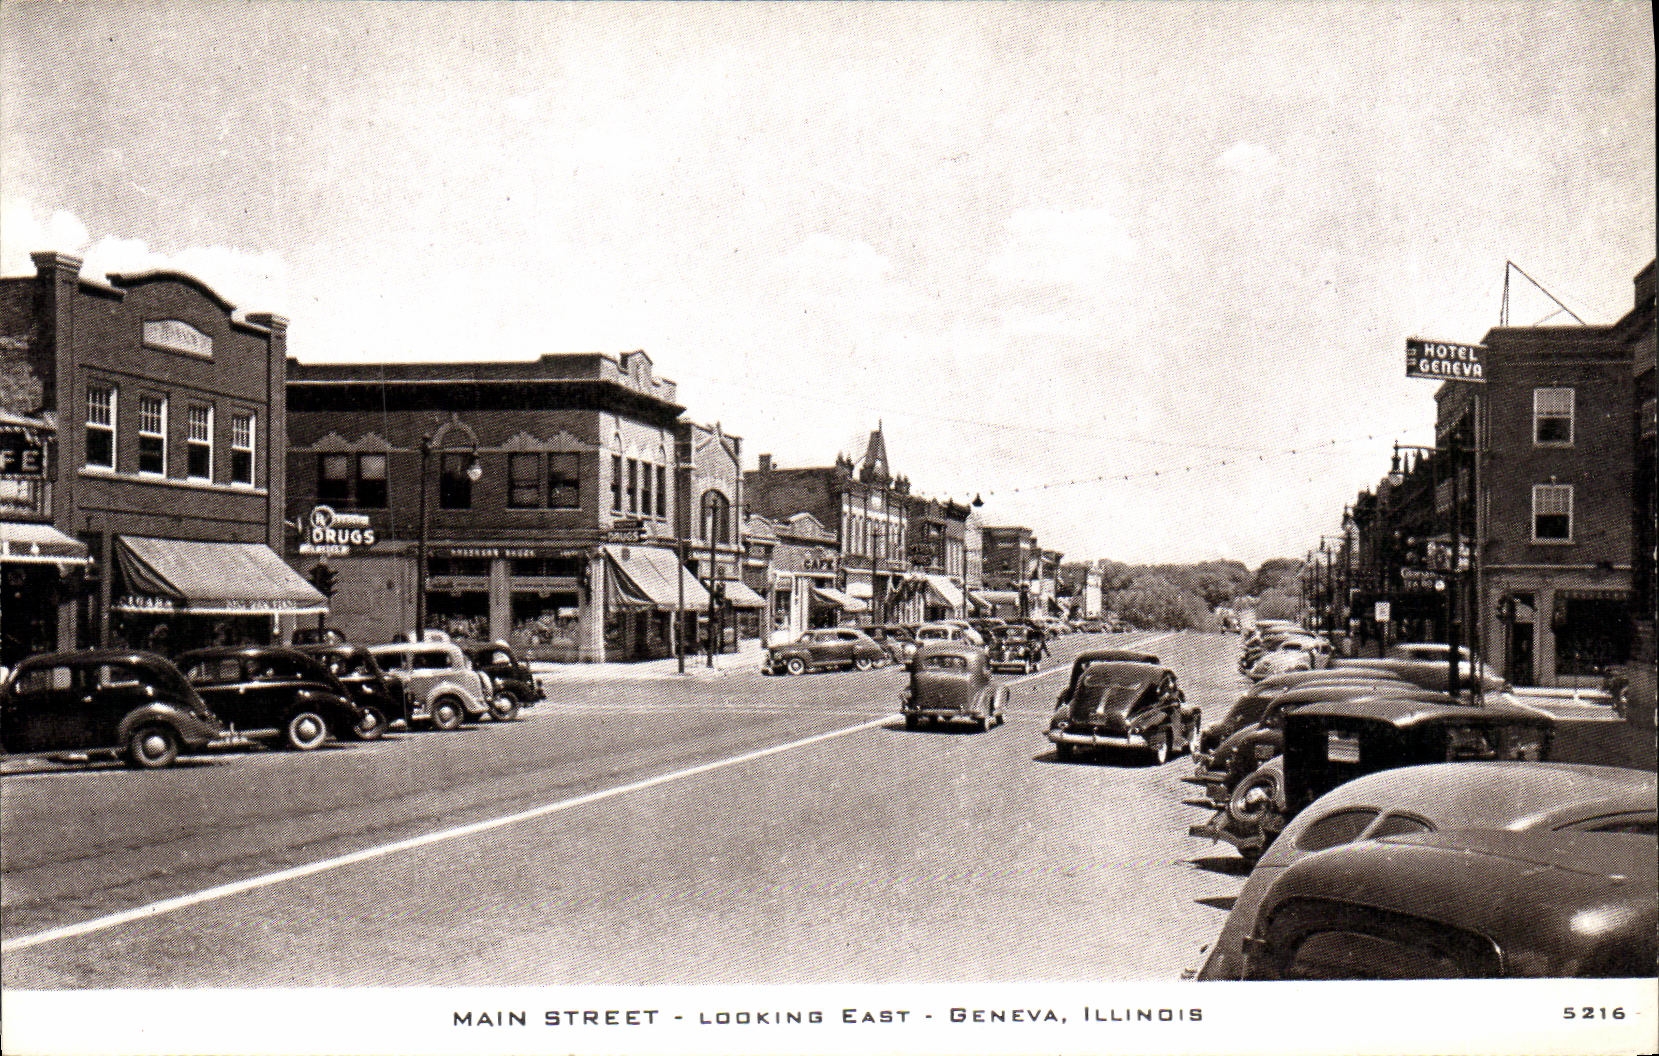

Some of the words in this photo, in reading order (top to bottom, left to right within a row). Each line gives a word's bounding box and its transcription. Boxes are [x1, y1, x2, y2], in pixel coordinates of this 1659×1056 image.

[1424, 343, 1479, 362] HOTEL
[312, 527, 375, 545] DRUGS
[804, 558, 834, 571] CAFE
